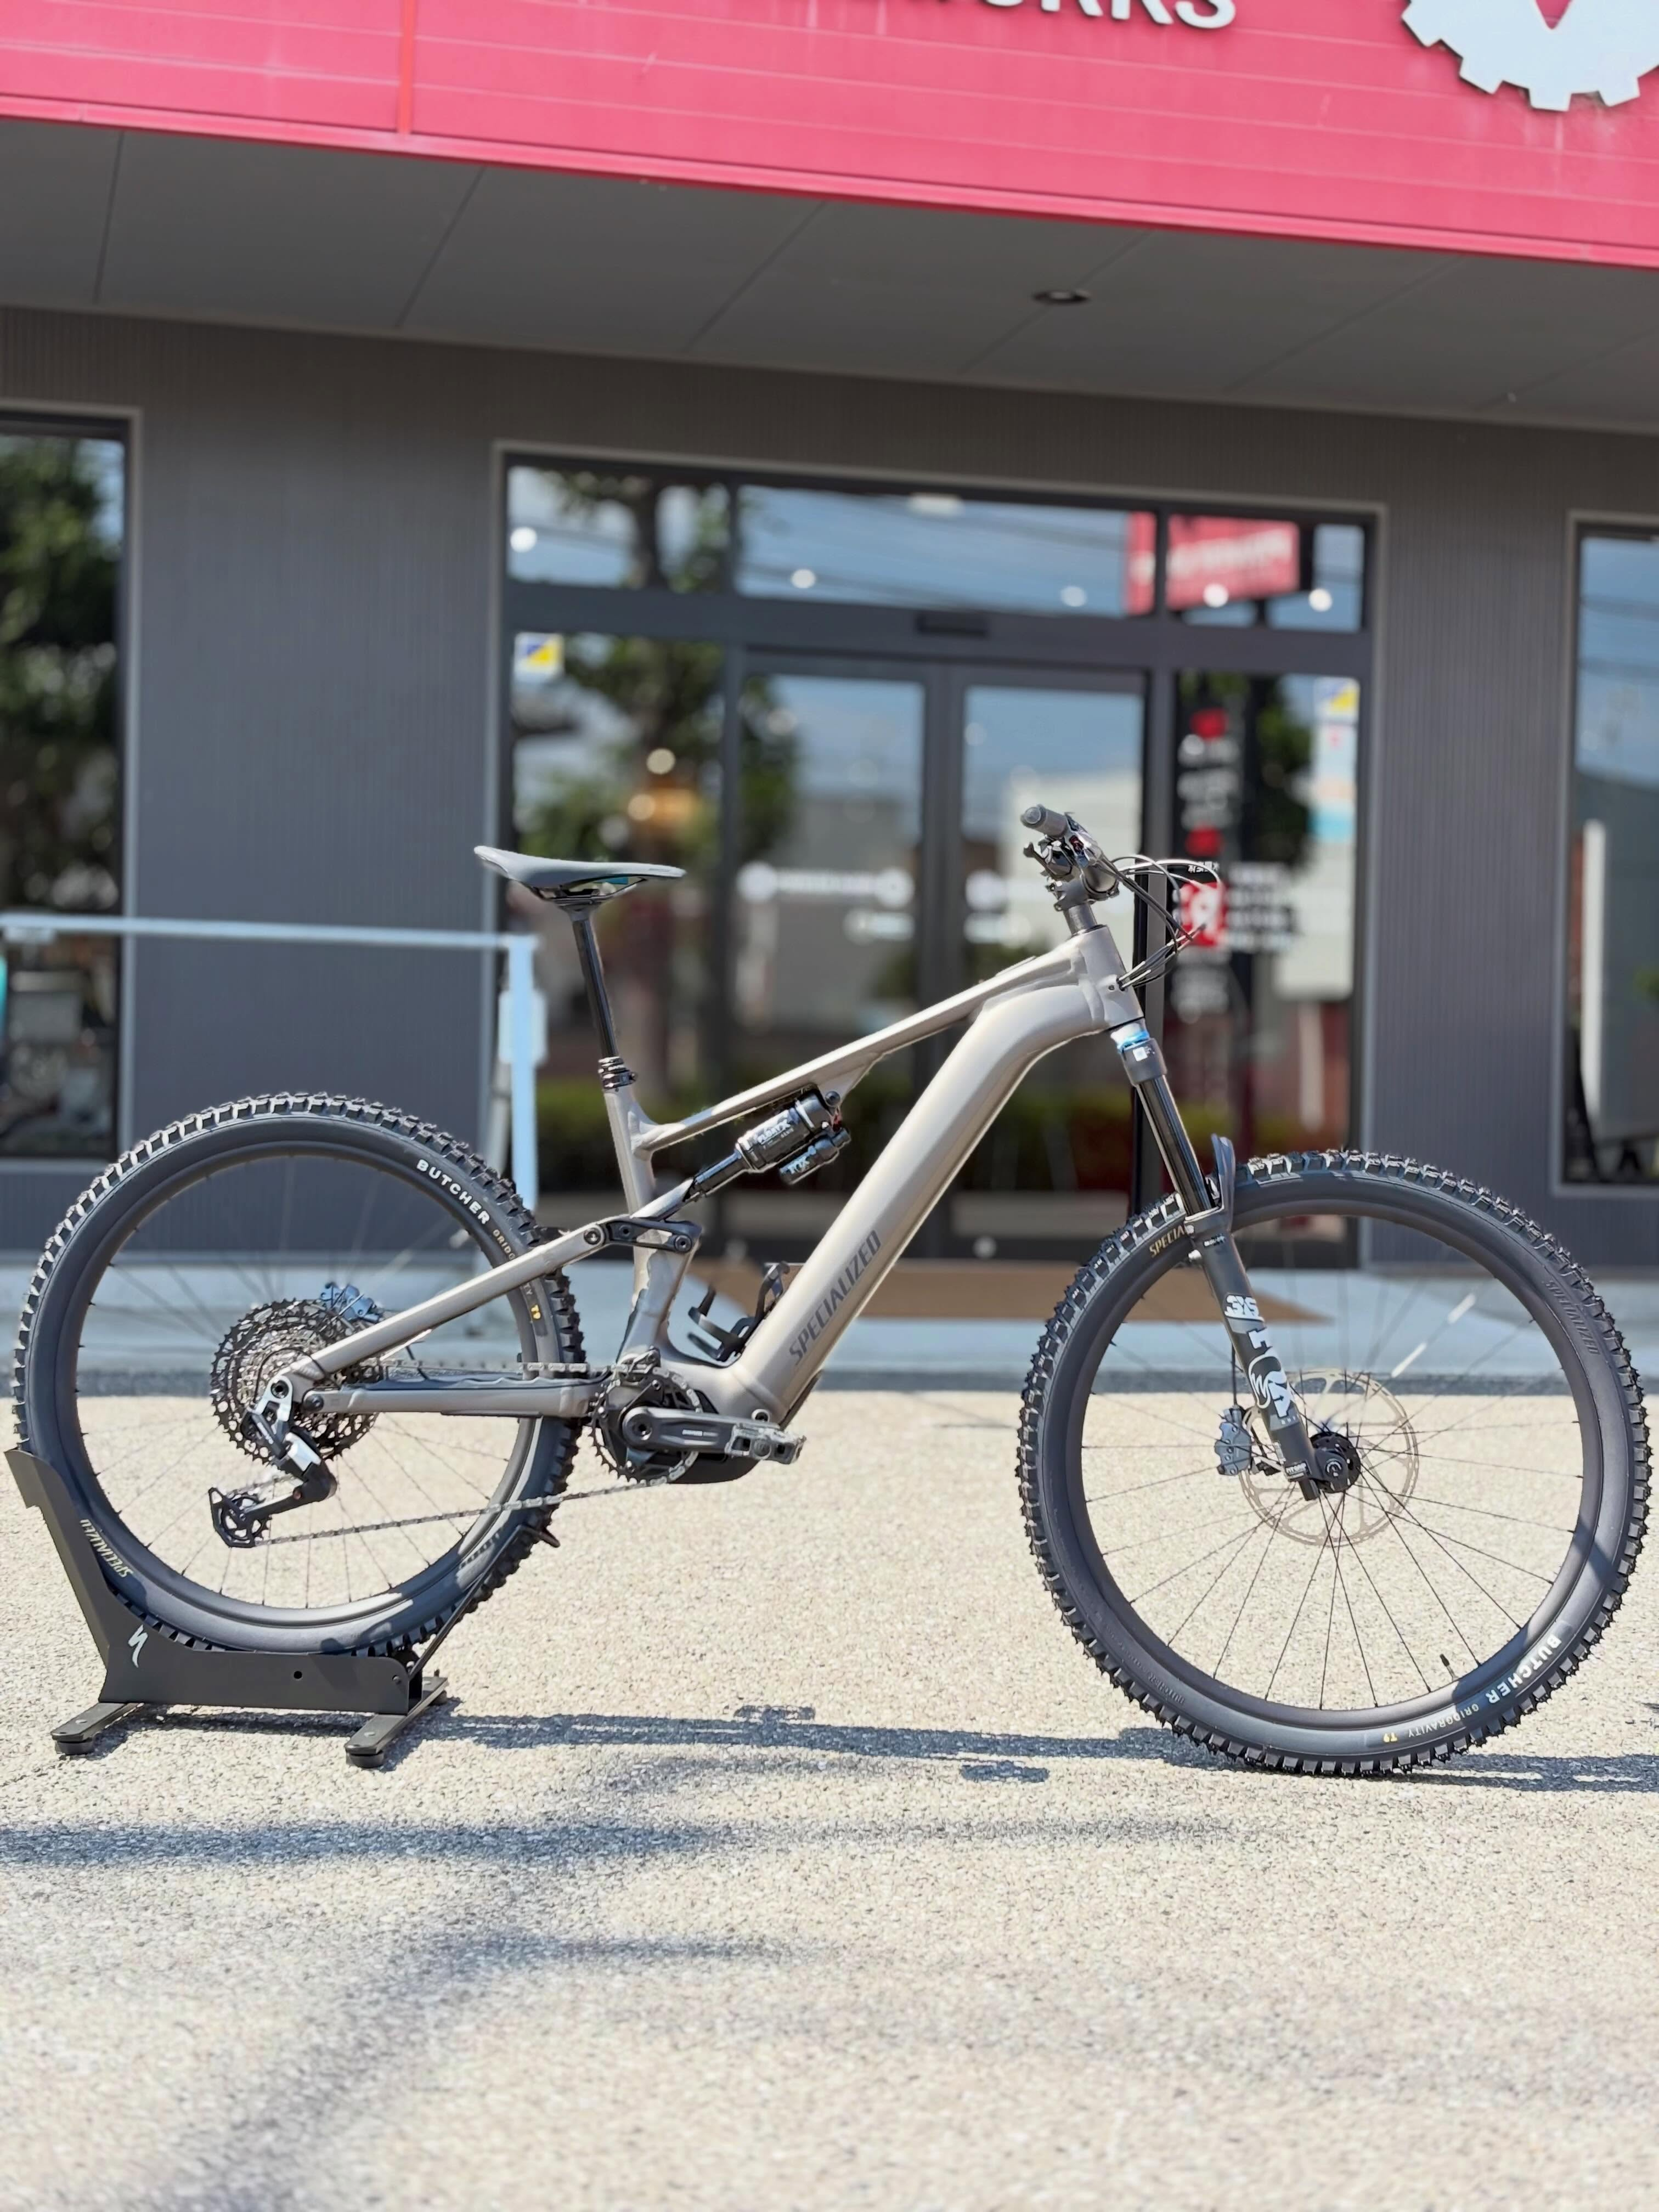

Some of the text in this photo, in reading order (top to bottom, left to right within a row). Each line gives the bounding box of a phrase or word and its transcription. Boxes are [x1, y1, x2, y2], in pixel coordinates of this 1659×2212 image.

[416, 1159, 490, 1224] BUTCHER
[789, 1229, 881, 1365] SPECIALIZED
[80, 1519, 134, 1578] SPECIALIZED
[1485, 1634, 1562, 1703] BUTCHER
